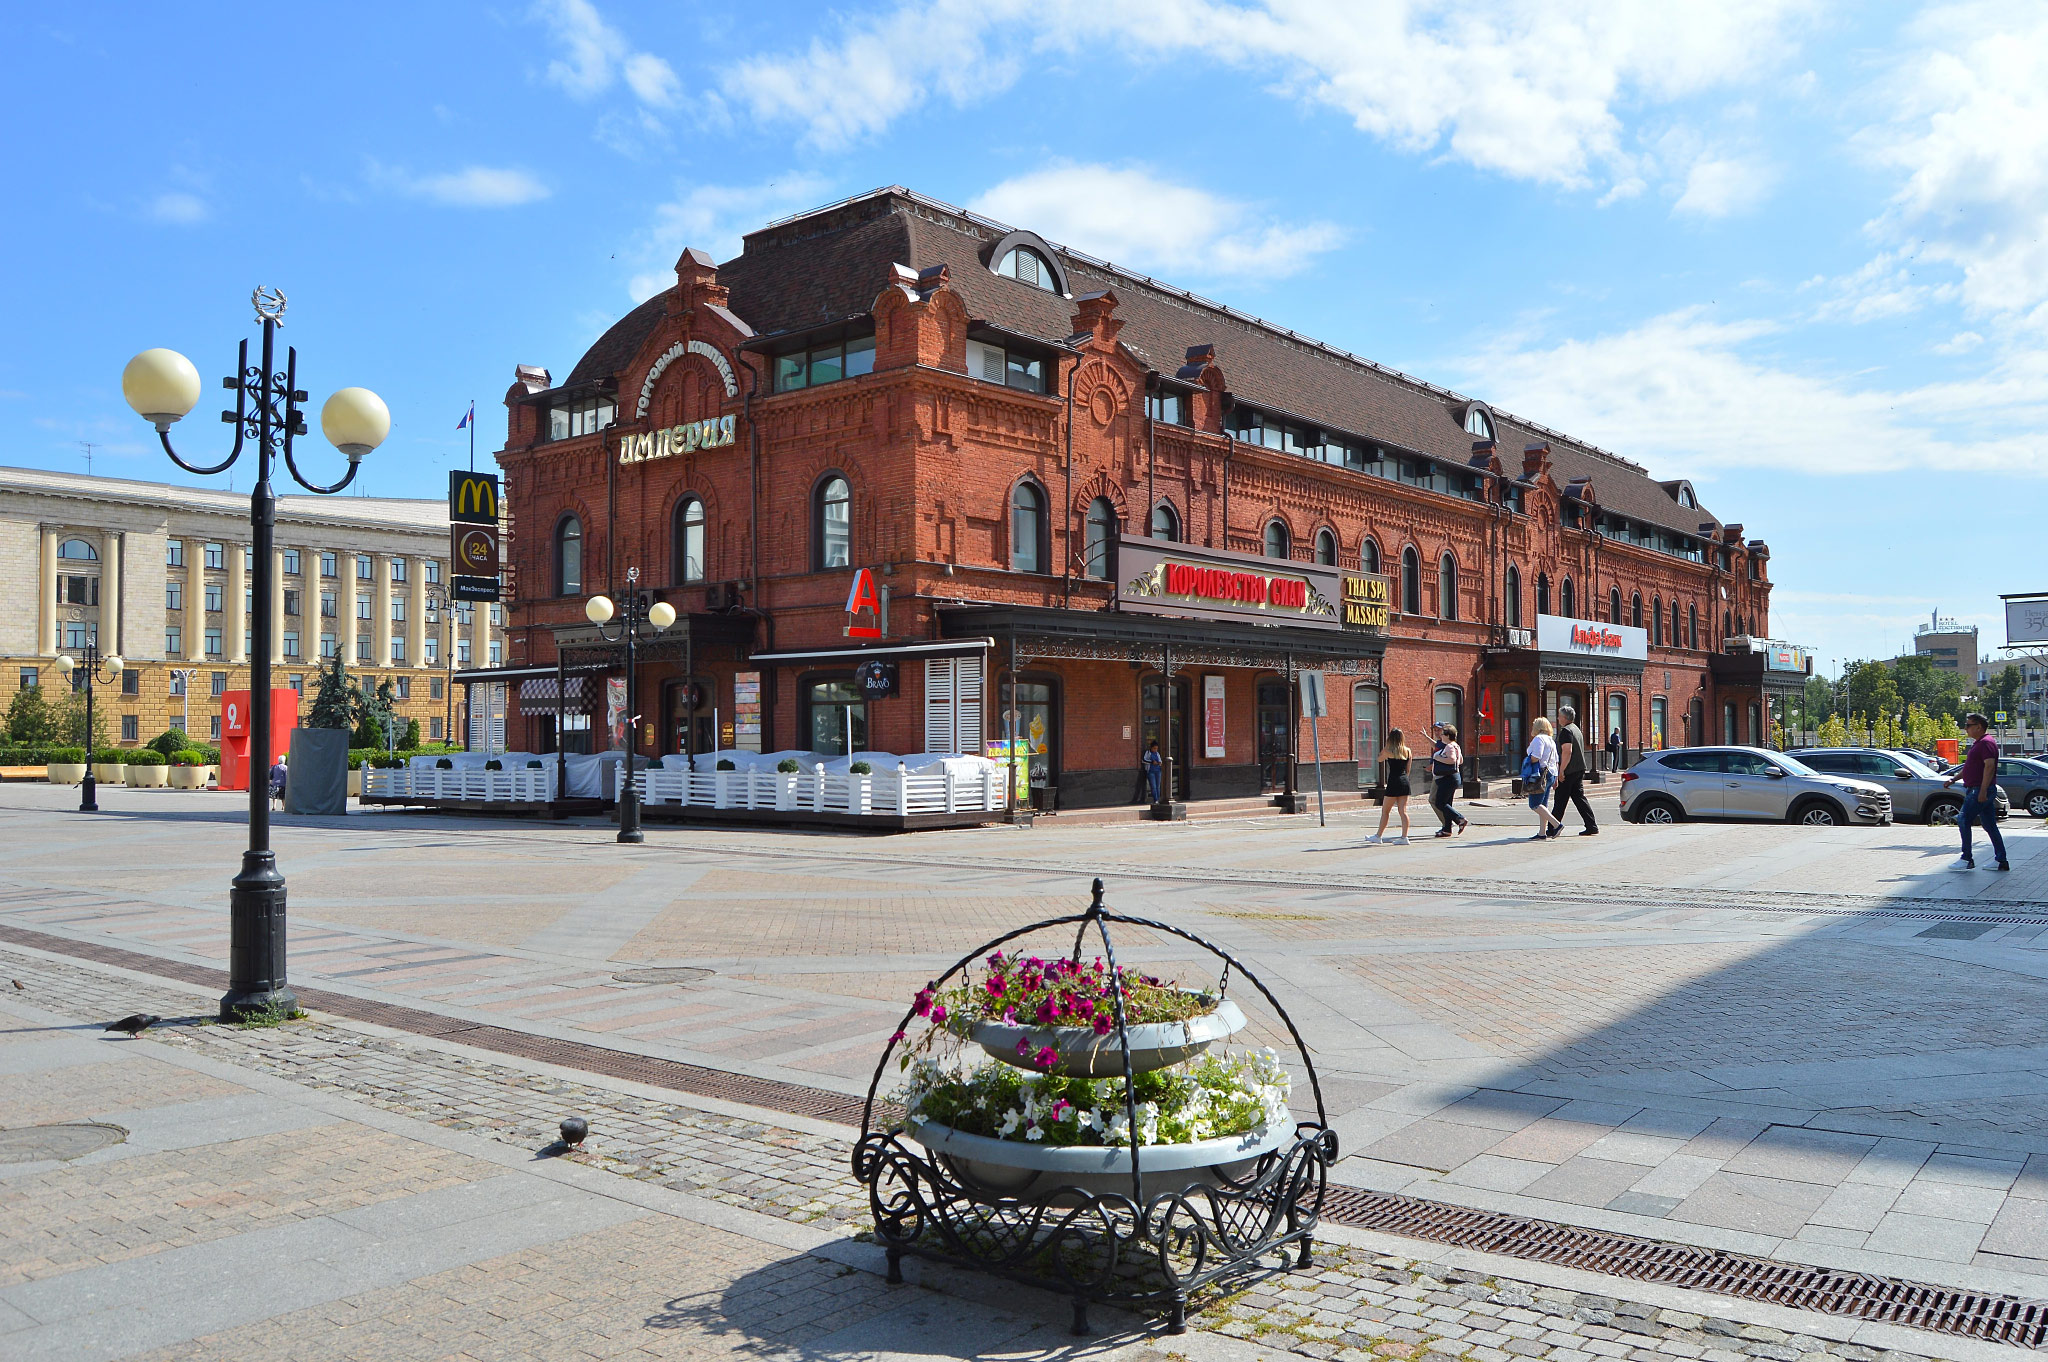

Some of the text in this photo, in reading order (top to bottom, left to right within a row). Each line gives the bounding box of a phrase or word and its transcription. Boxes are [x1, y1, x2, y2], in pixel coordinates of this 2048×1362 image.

[636, 340, 738, 419] ТОРГОВЫЙ КОМПЛЕКС
[472, 542, 488, 555] 24
[1165, 563, 1307, 608] КОРОЛЕВСТВО СИАМ
[1347, 576, 1388, 600] THAI SPA
[1346, 604, 1388, 627] MASSAGE
[1572, 623, 1622, 648] Альфа-Банк
[228, 704, 237, 729] 9
